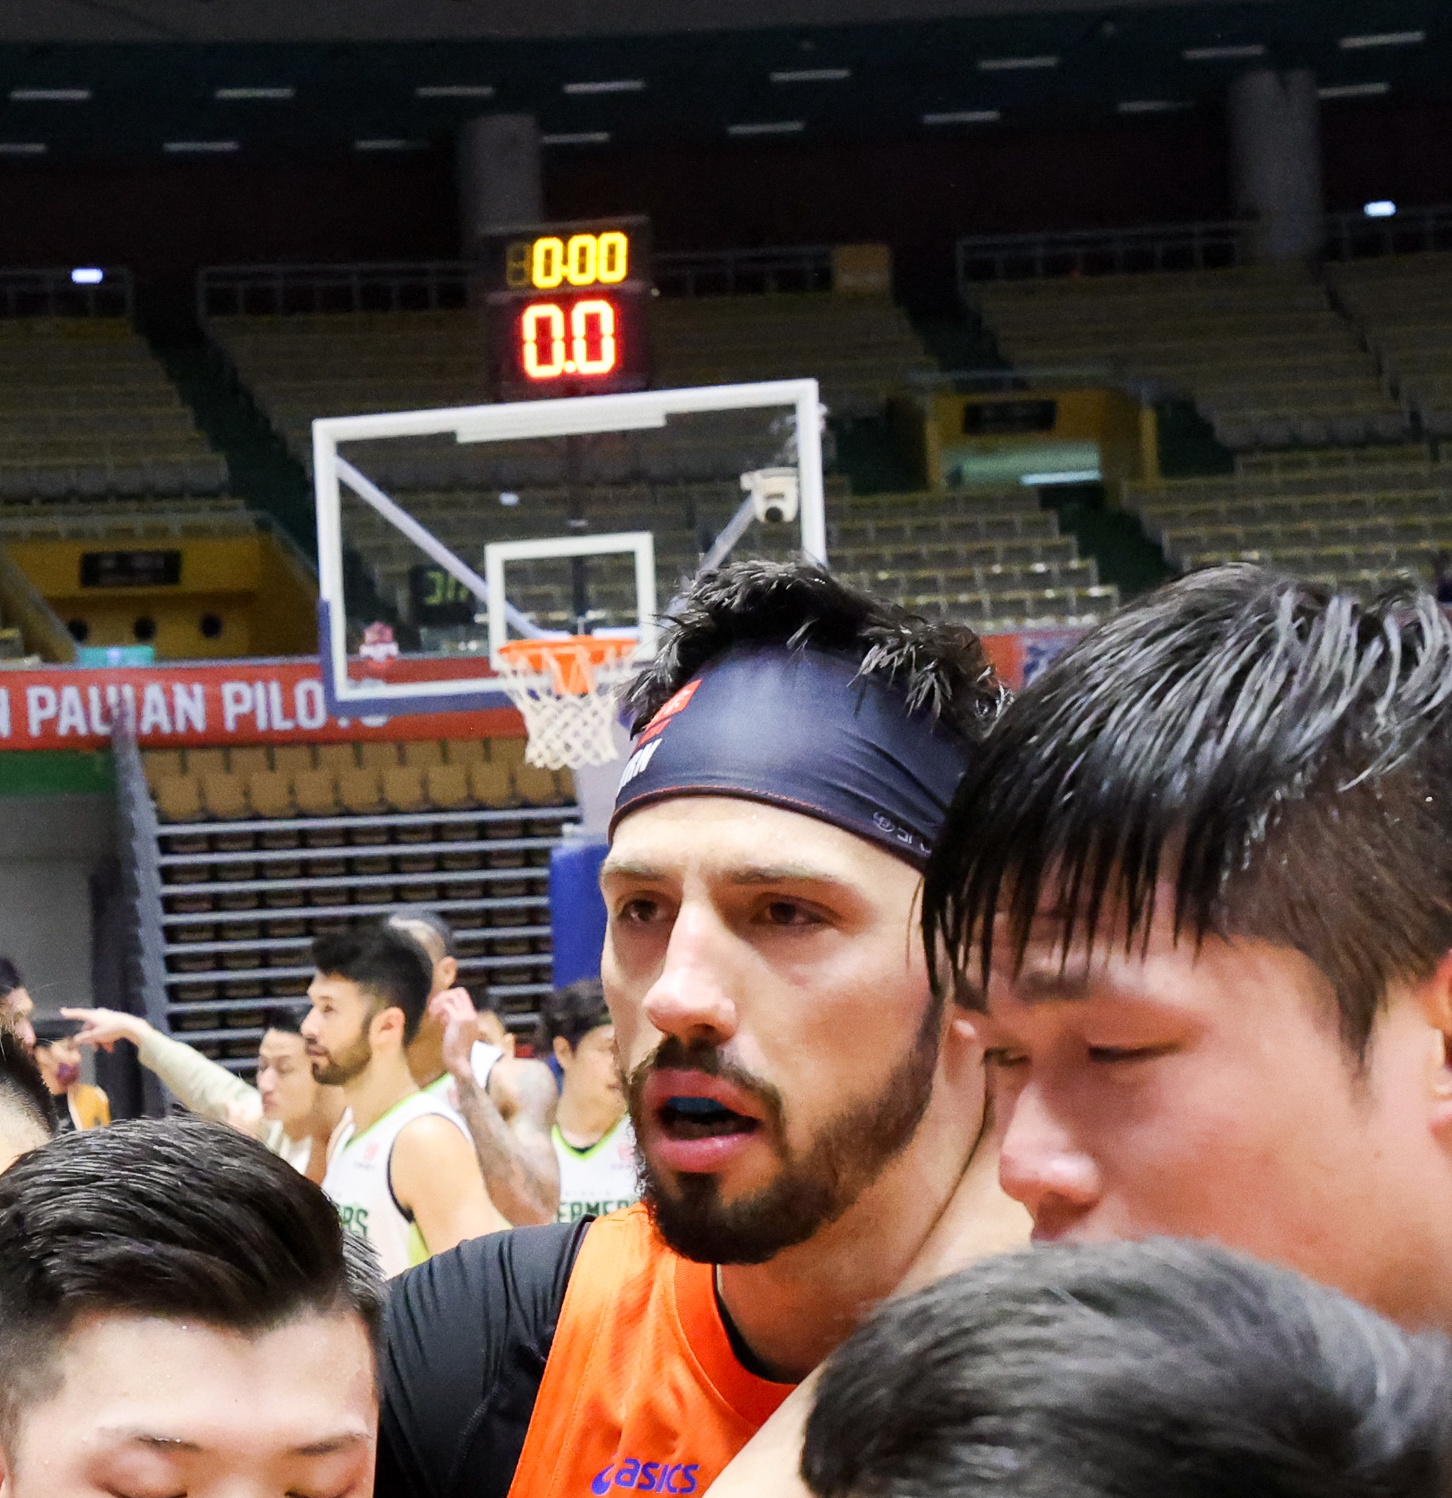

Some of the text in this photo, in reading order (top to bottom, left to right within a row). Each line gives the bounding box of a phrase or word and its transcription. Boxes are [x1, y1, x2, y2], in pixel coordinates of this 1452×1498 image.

[522, 299, 615, 379] 0.0
[26, 682, 207, 737] PAUIAN
[615, 1457, 699, 1494] asics
